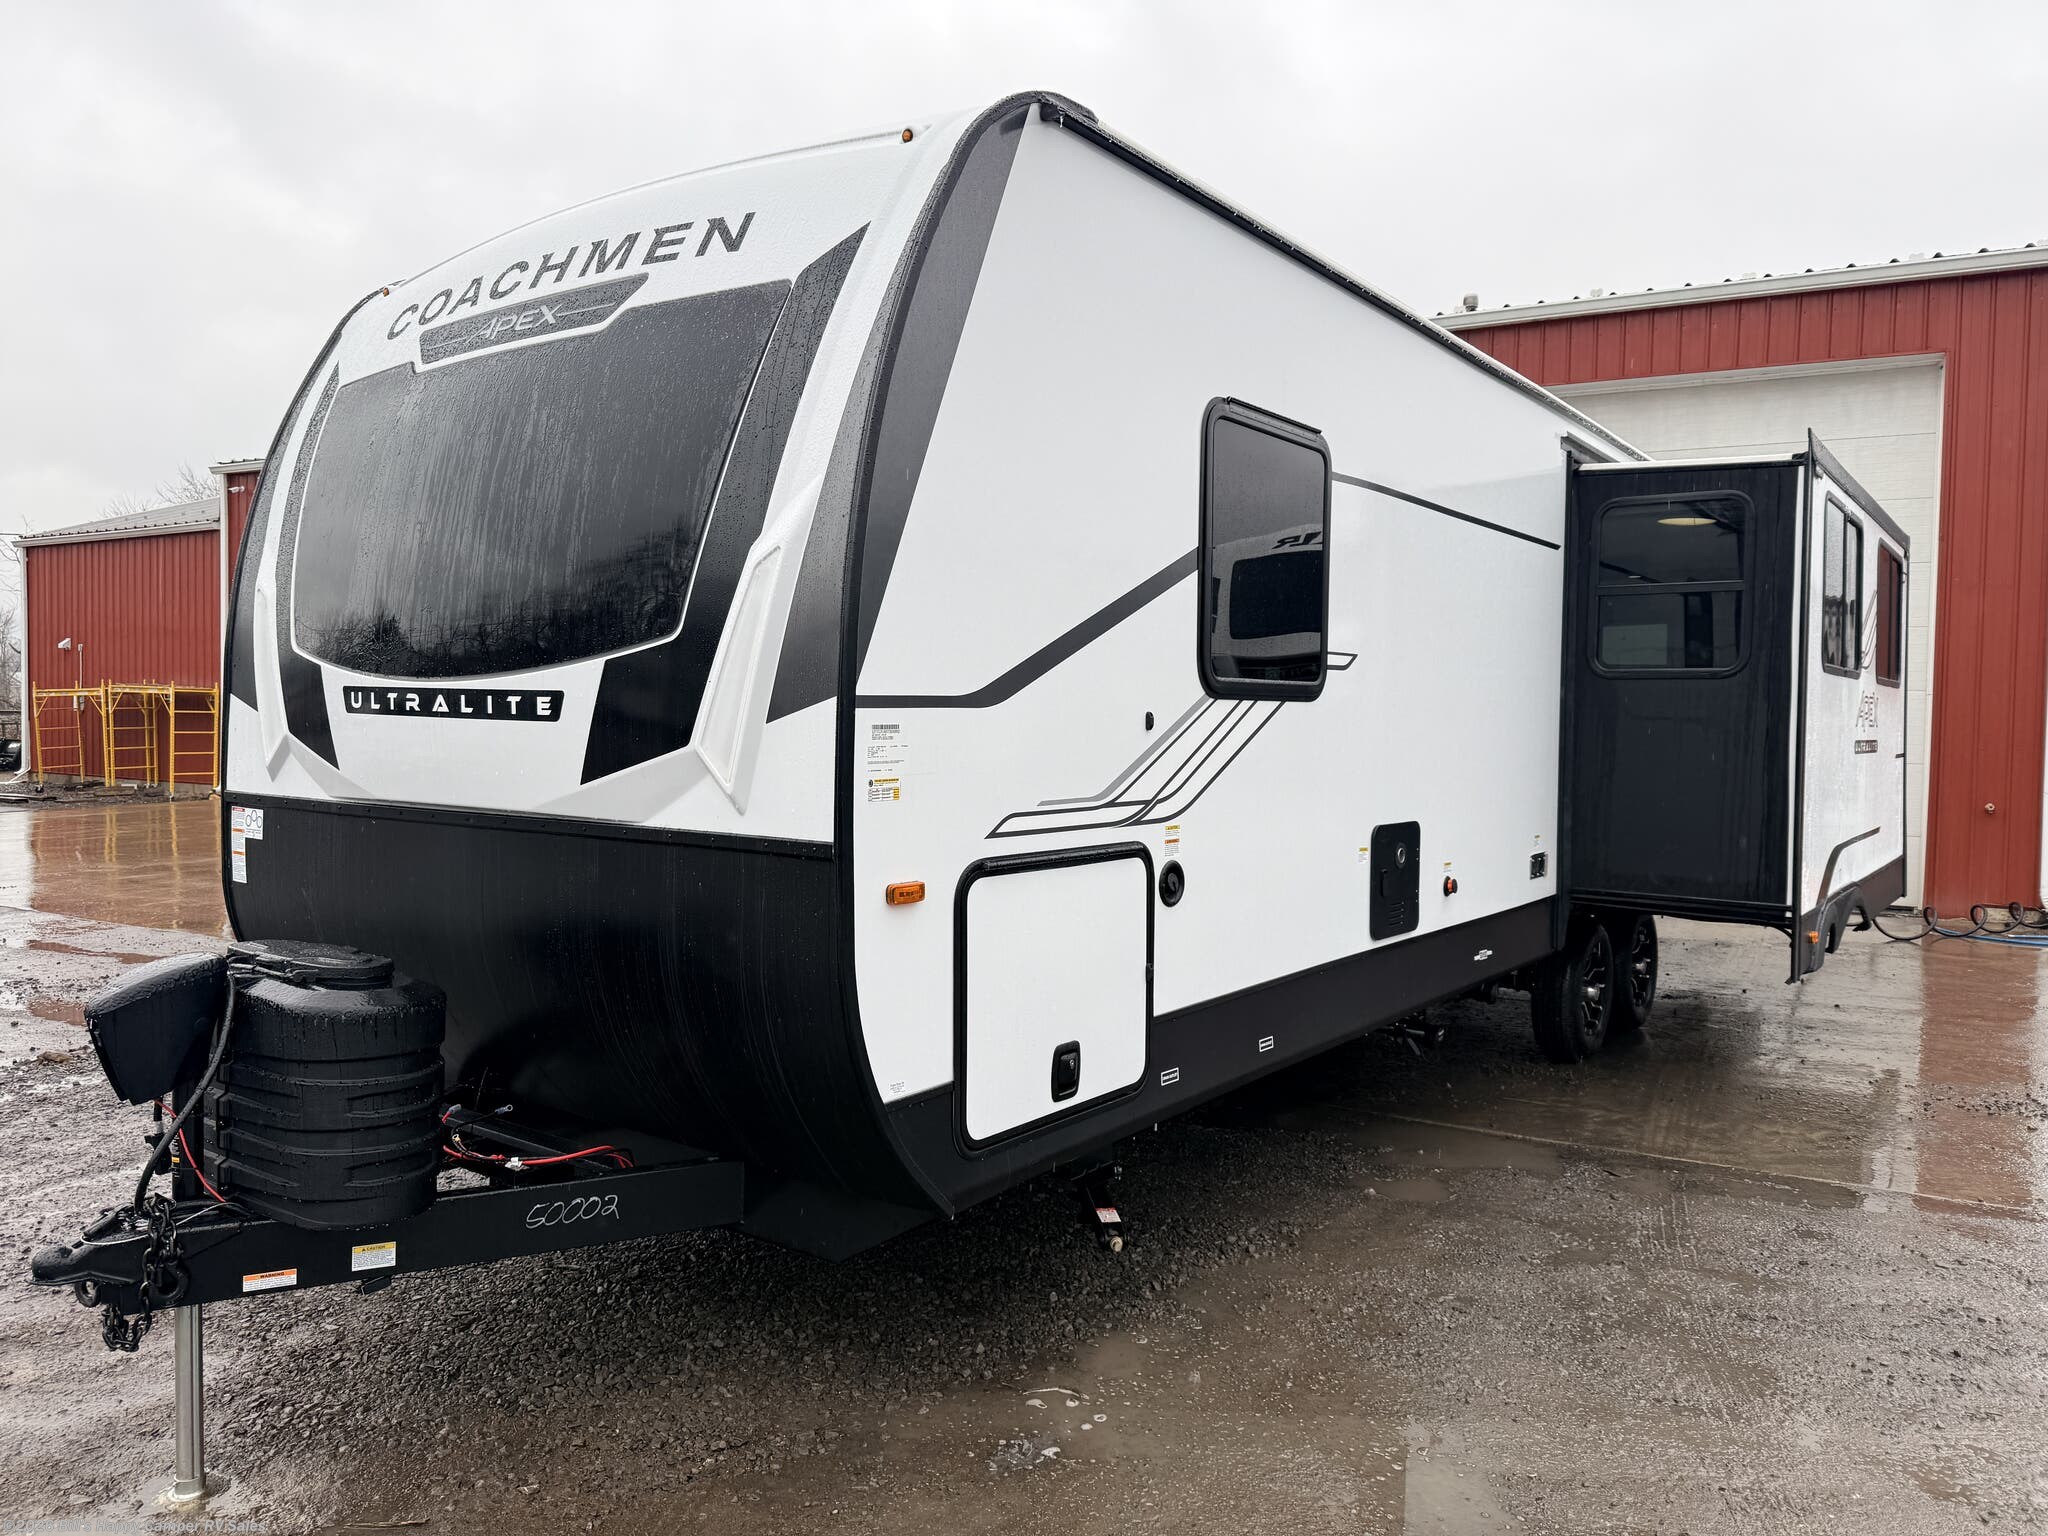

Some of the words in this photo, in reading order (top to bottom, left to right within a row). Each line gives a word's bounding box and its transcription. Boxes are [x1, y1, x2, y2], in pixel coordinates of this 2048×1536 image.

[387, 211, 756, 341] COACHMEN
[471, 303, 564, 341] APEX
[350, 691, 552, 716] ULTRALITE
[526, 1194, 620, 1229] 50002
[366, 1244, 386, 1252] CAUTION
[260, 1271, 285, 1279] WARNING
